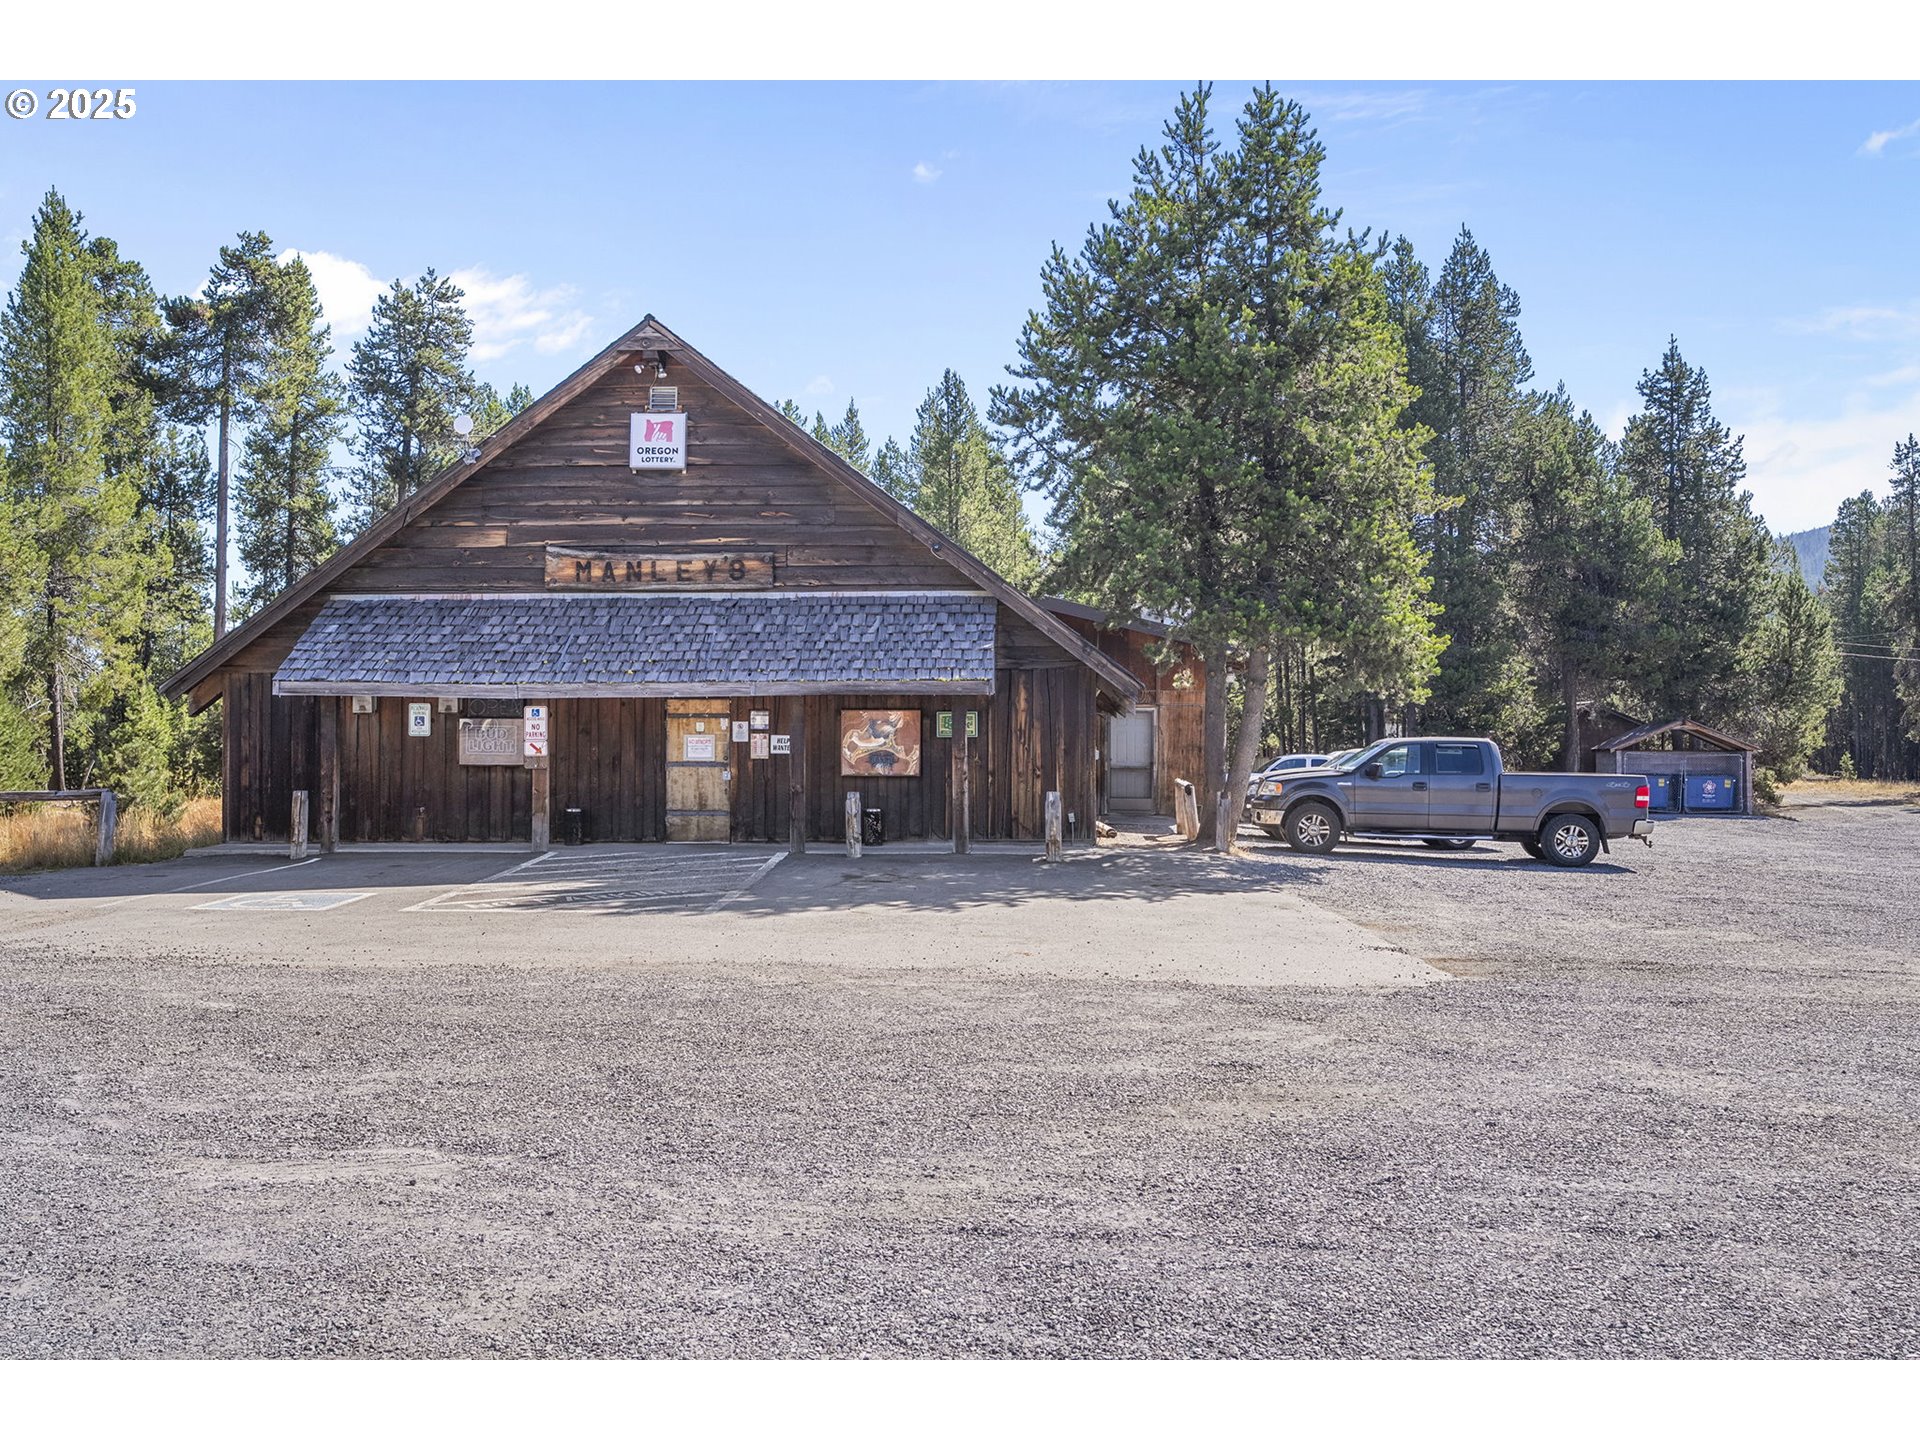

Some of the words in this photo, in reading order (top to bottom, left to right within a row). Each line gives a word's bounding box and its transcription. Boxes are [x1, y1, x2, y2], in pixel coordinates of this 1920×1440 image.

[636, 446, 679, 455] OREGON
[531, 723, 541, 731] NO
[475, 728, 508, 740] BUD
[469, 740, 514, 752] LIGHT
